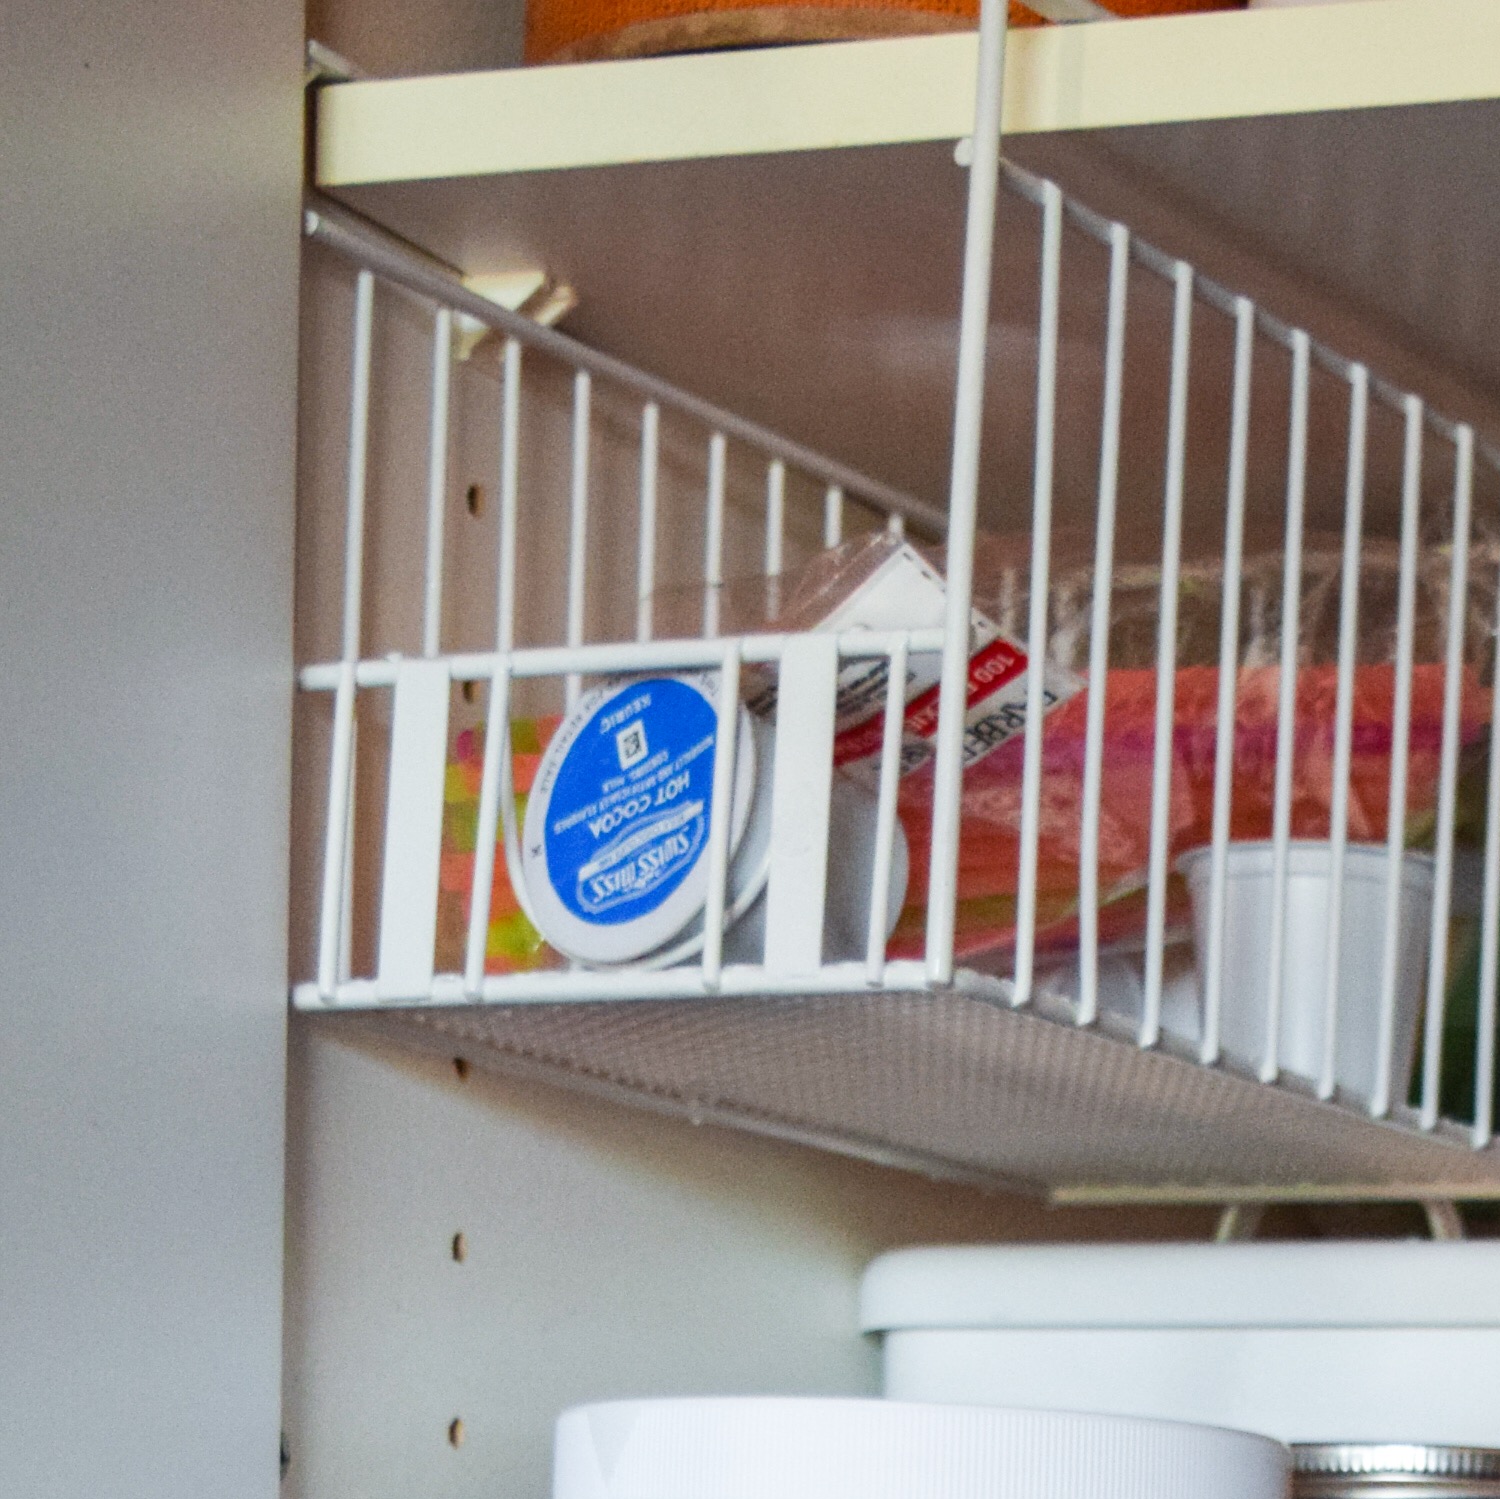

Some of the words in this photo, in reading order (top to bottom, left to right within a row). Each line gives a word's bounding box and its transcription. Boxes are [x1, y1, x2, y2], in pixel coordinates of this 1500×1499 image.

[599, 692, 652, 735] KEURIG
[654, 769, 692, 807] HOT
[586, 794, 652, 839] COCOA
